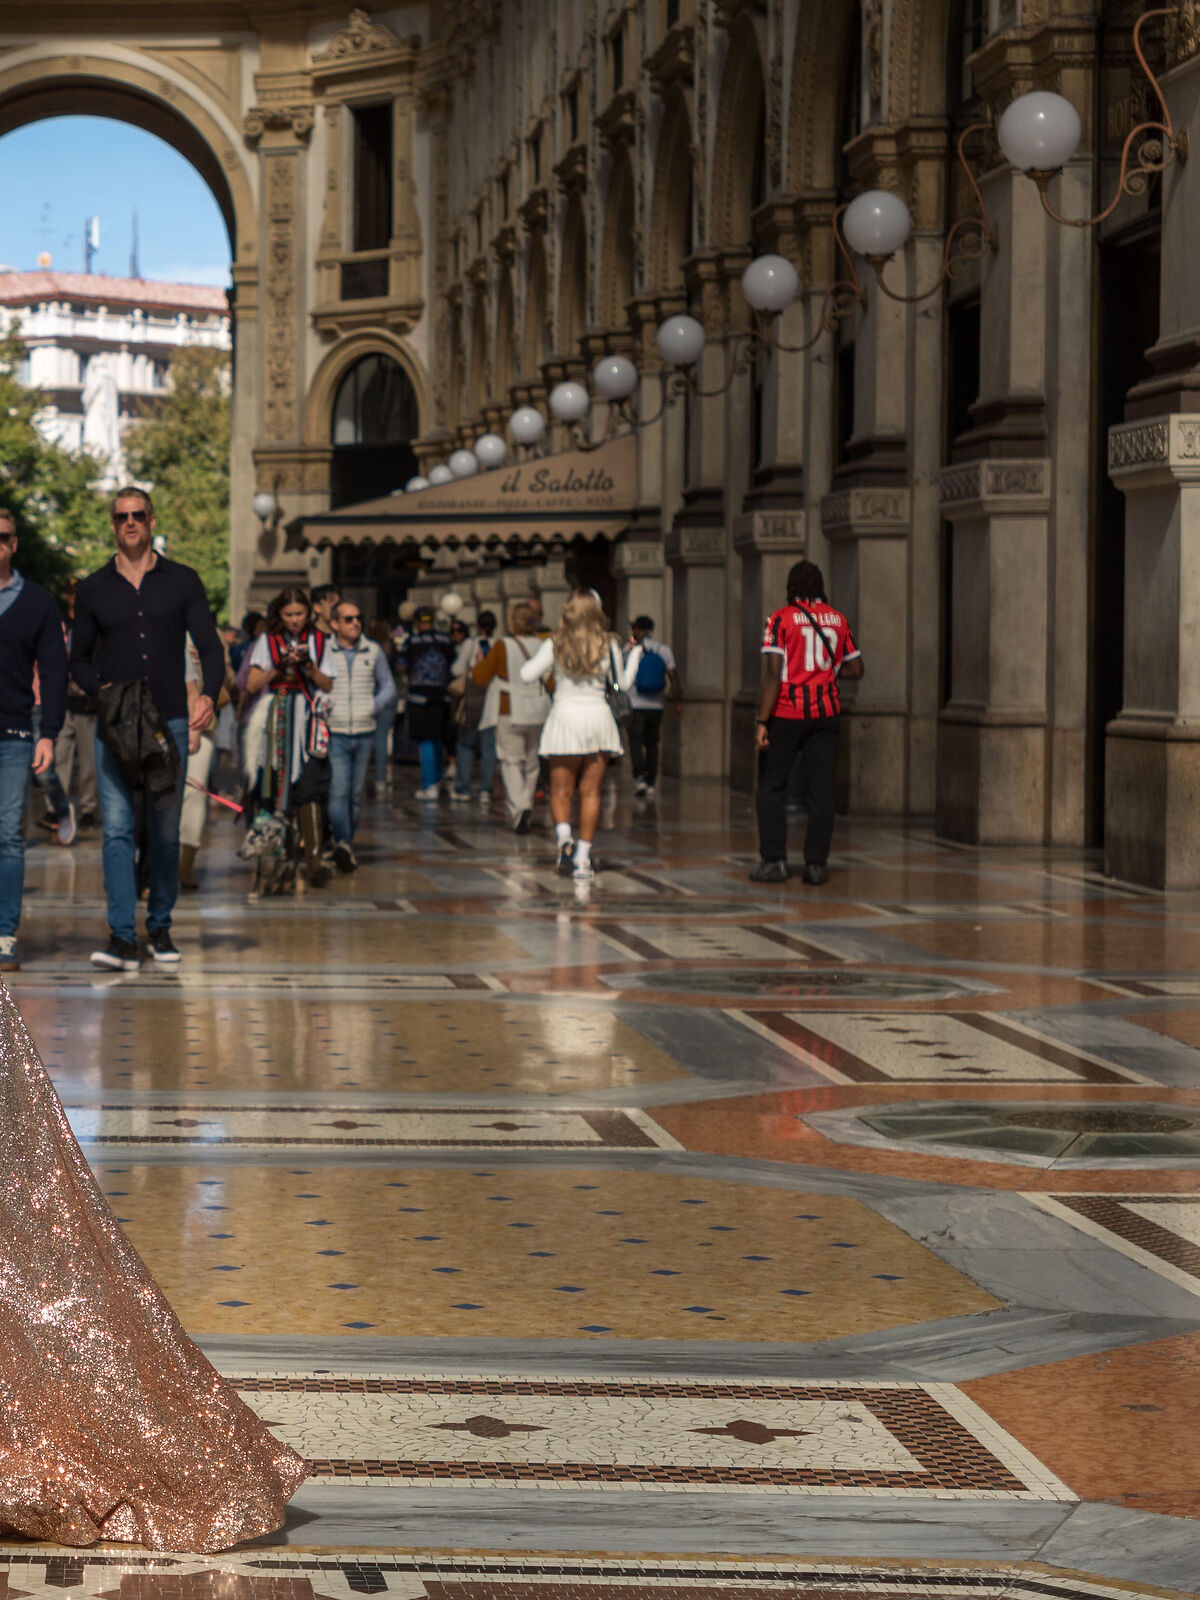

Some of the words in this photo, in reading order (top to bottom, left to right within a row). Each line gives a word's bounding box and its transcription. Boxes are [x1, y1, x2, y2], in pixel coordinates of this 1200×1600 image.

[501, 469, 521, 493] il
[528, 467, 615, 493] Salotto
[800, 625, 838, 672] 10
